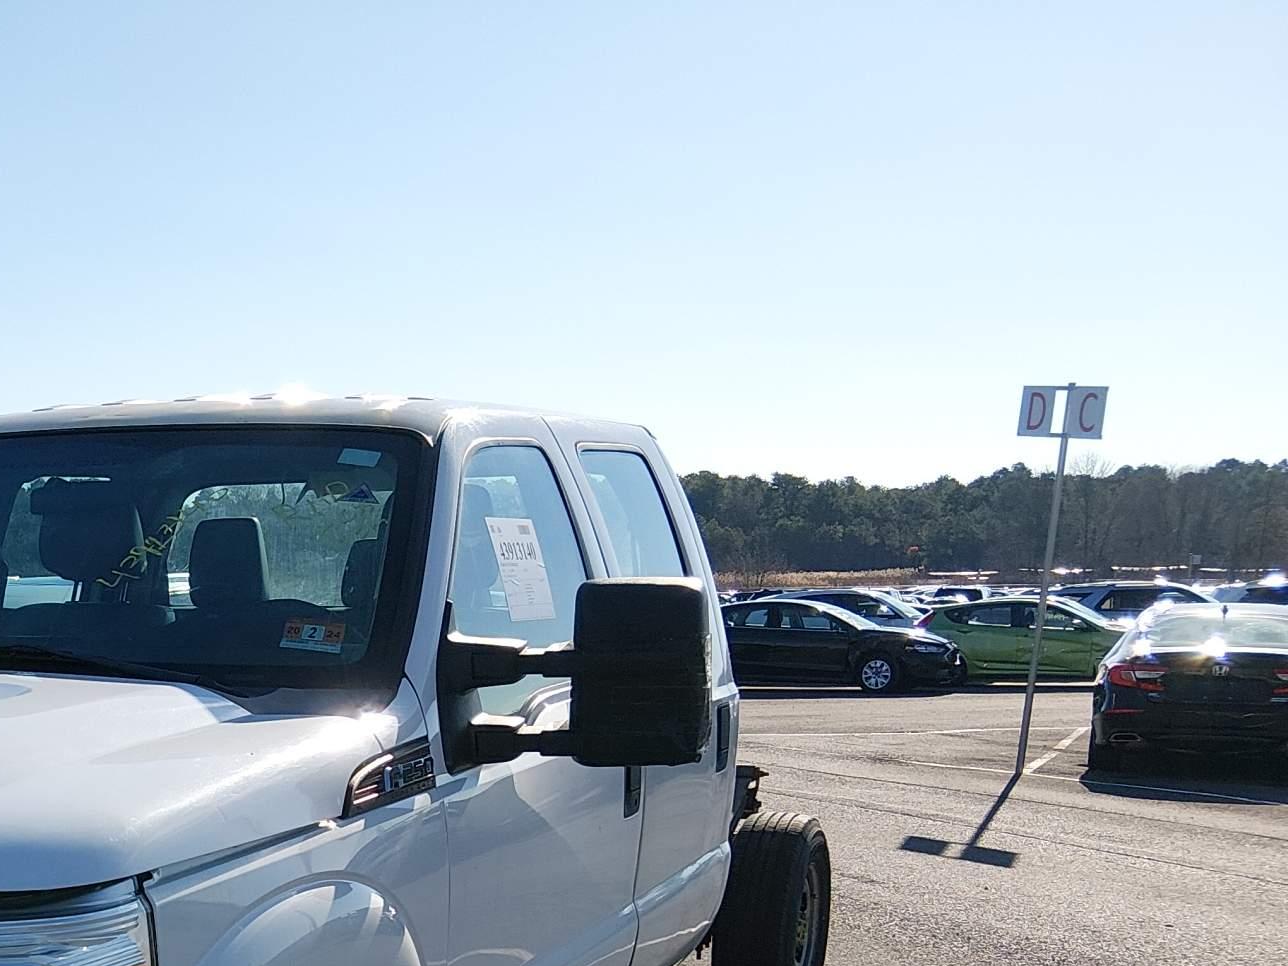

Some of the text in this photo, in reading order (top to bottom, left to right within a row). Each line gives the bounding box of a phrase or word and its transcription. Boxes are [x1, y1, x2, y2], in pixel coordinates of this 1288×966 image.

[1026, 391, 1047, 431] D
[1079, 392, 1099, 433] C
[499, 541, 537, 561] 43913140
[307, 626, 318, 639] 2
